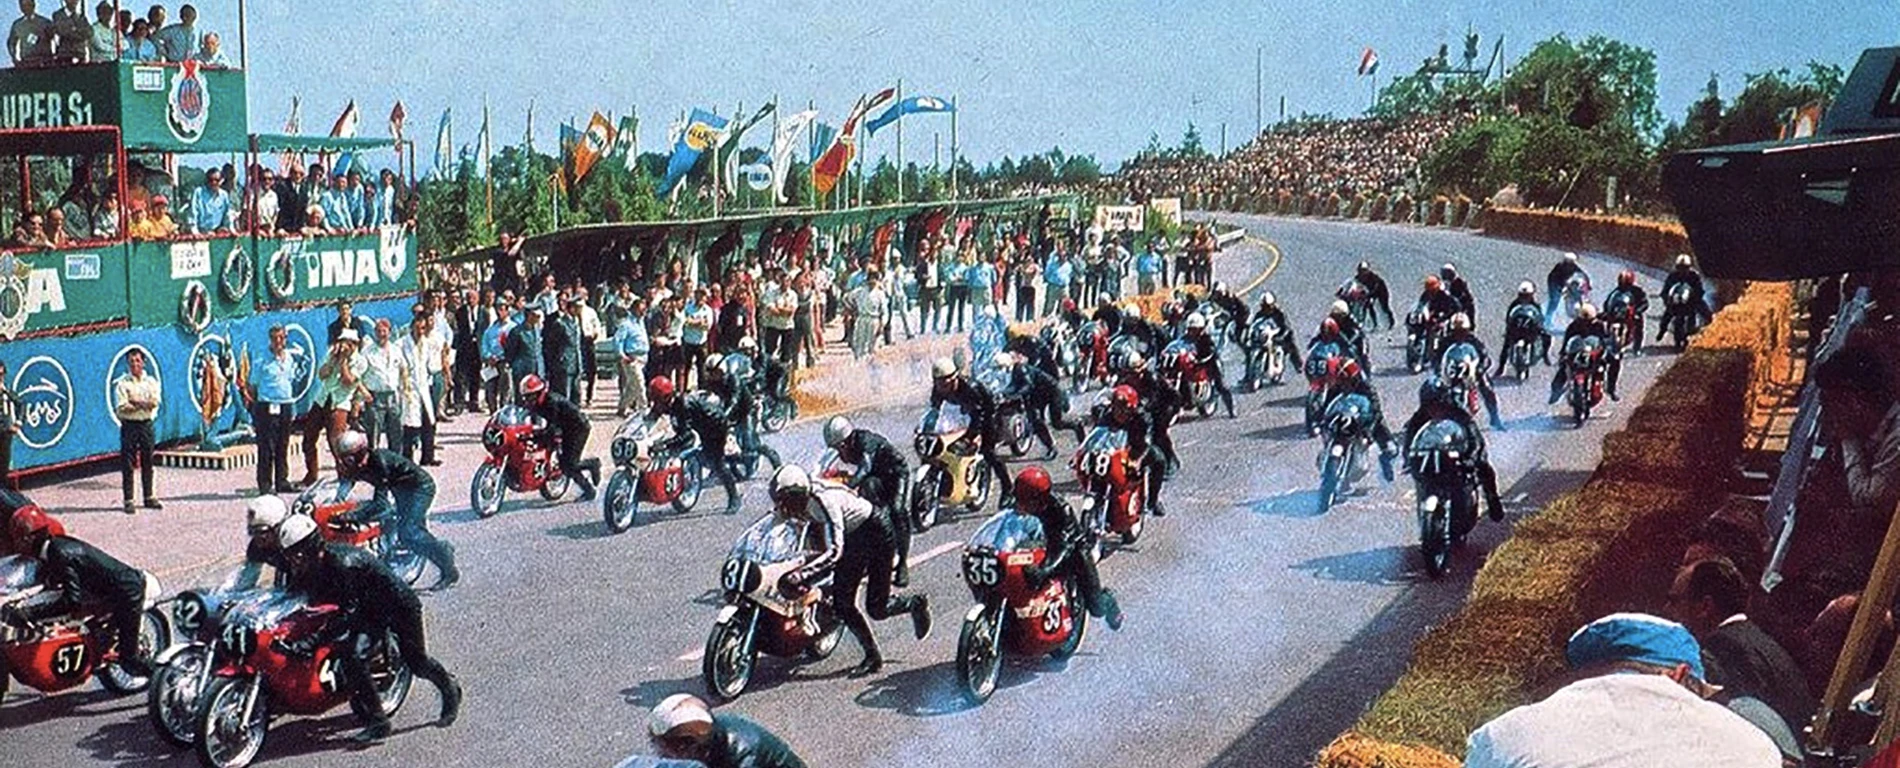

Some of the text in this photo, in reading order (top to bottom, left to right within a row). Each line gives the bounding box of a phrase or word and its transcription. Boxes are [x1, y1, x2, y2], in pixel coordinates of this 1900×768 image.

[0, 92, 62, 129] UPER
[613, 439, 635, 457] 58
[1417, 451, 1440, 473] 71
[1081, 452, 1110, 476] 48
[725, 559, 750, 592] 31
[968, 557, 998, 585] 35
[222, 623, 248, 654] 41
[58, 644, 85, 674] 57
